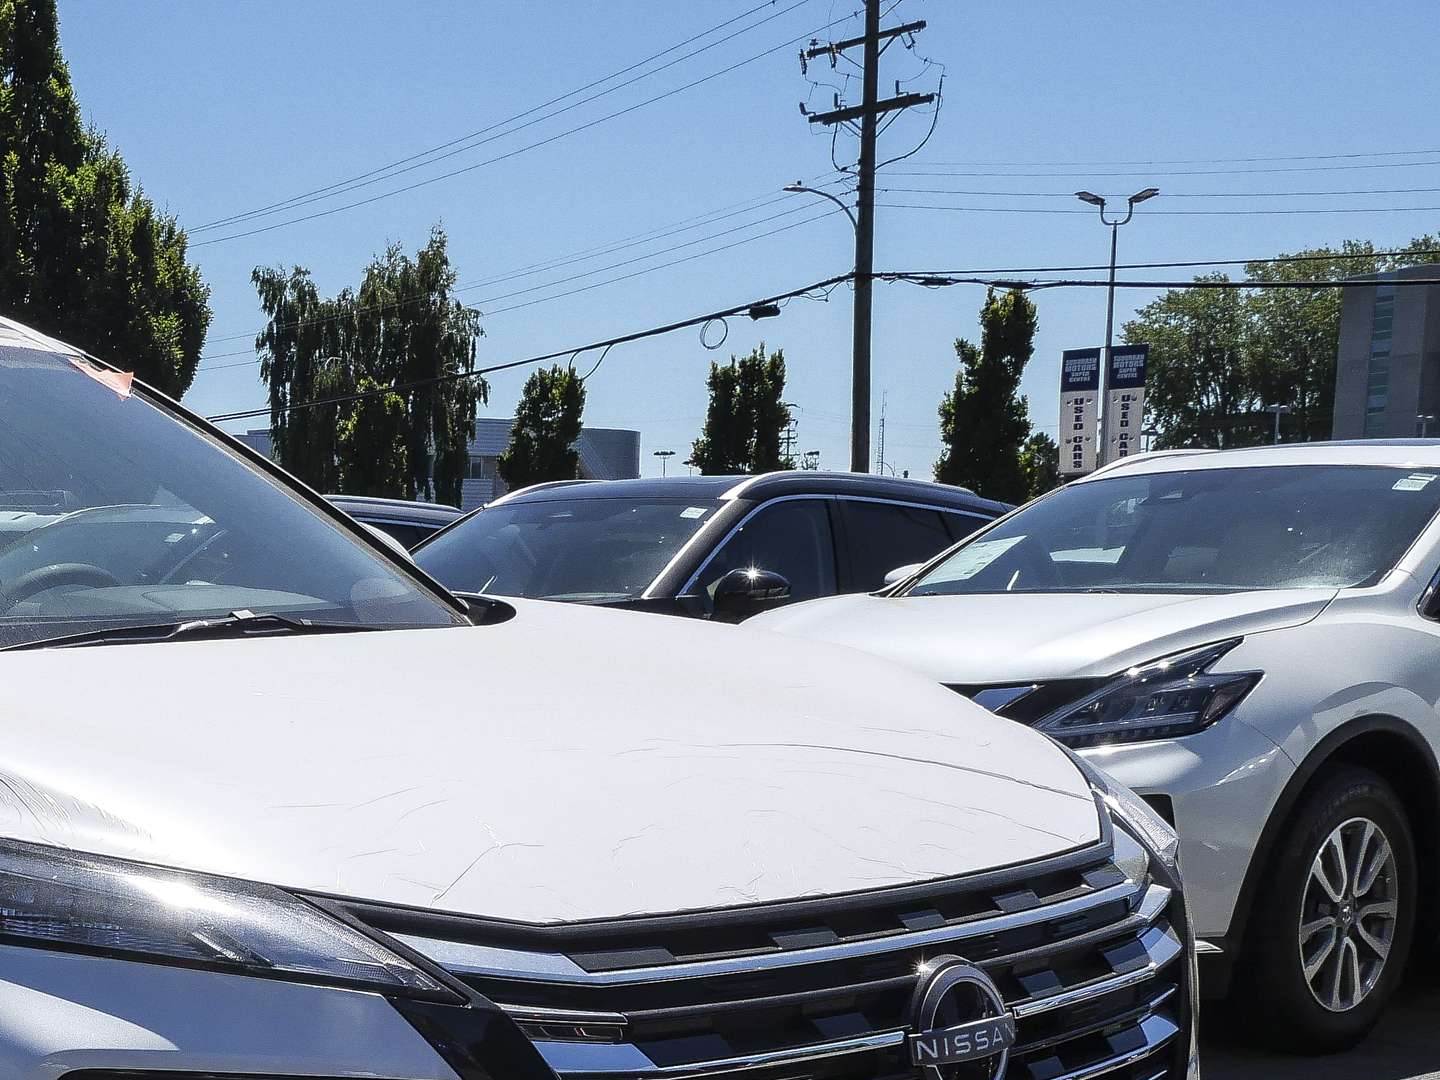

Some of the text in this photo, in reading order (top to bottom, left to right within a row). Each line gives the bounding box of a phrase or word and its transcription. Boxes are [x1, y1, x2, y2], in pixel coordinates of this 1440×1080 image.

[1065, 363, 1096, 372] MOTORS
[1113, 360, 1143, 369] MOTORS
[1072, 397, 1084, 469] USED CARS
[1118, 394, 1131, 457] USED CAR
[916, 1022, 1016, 1060] NISSAN
